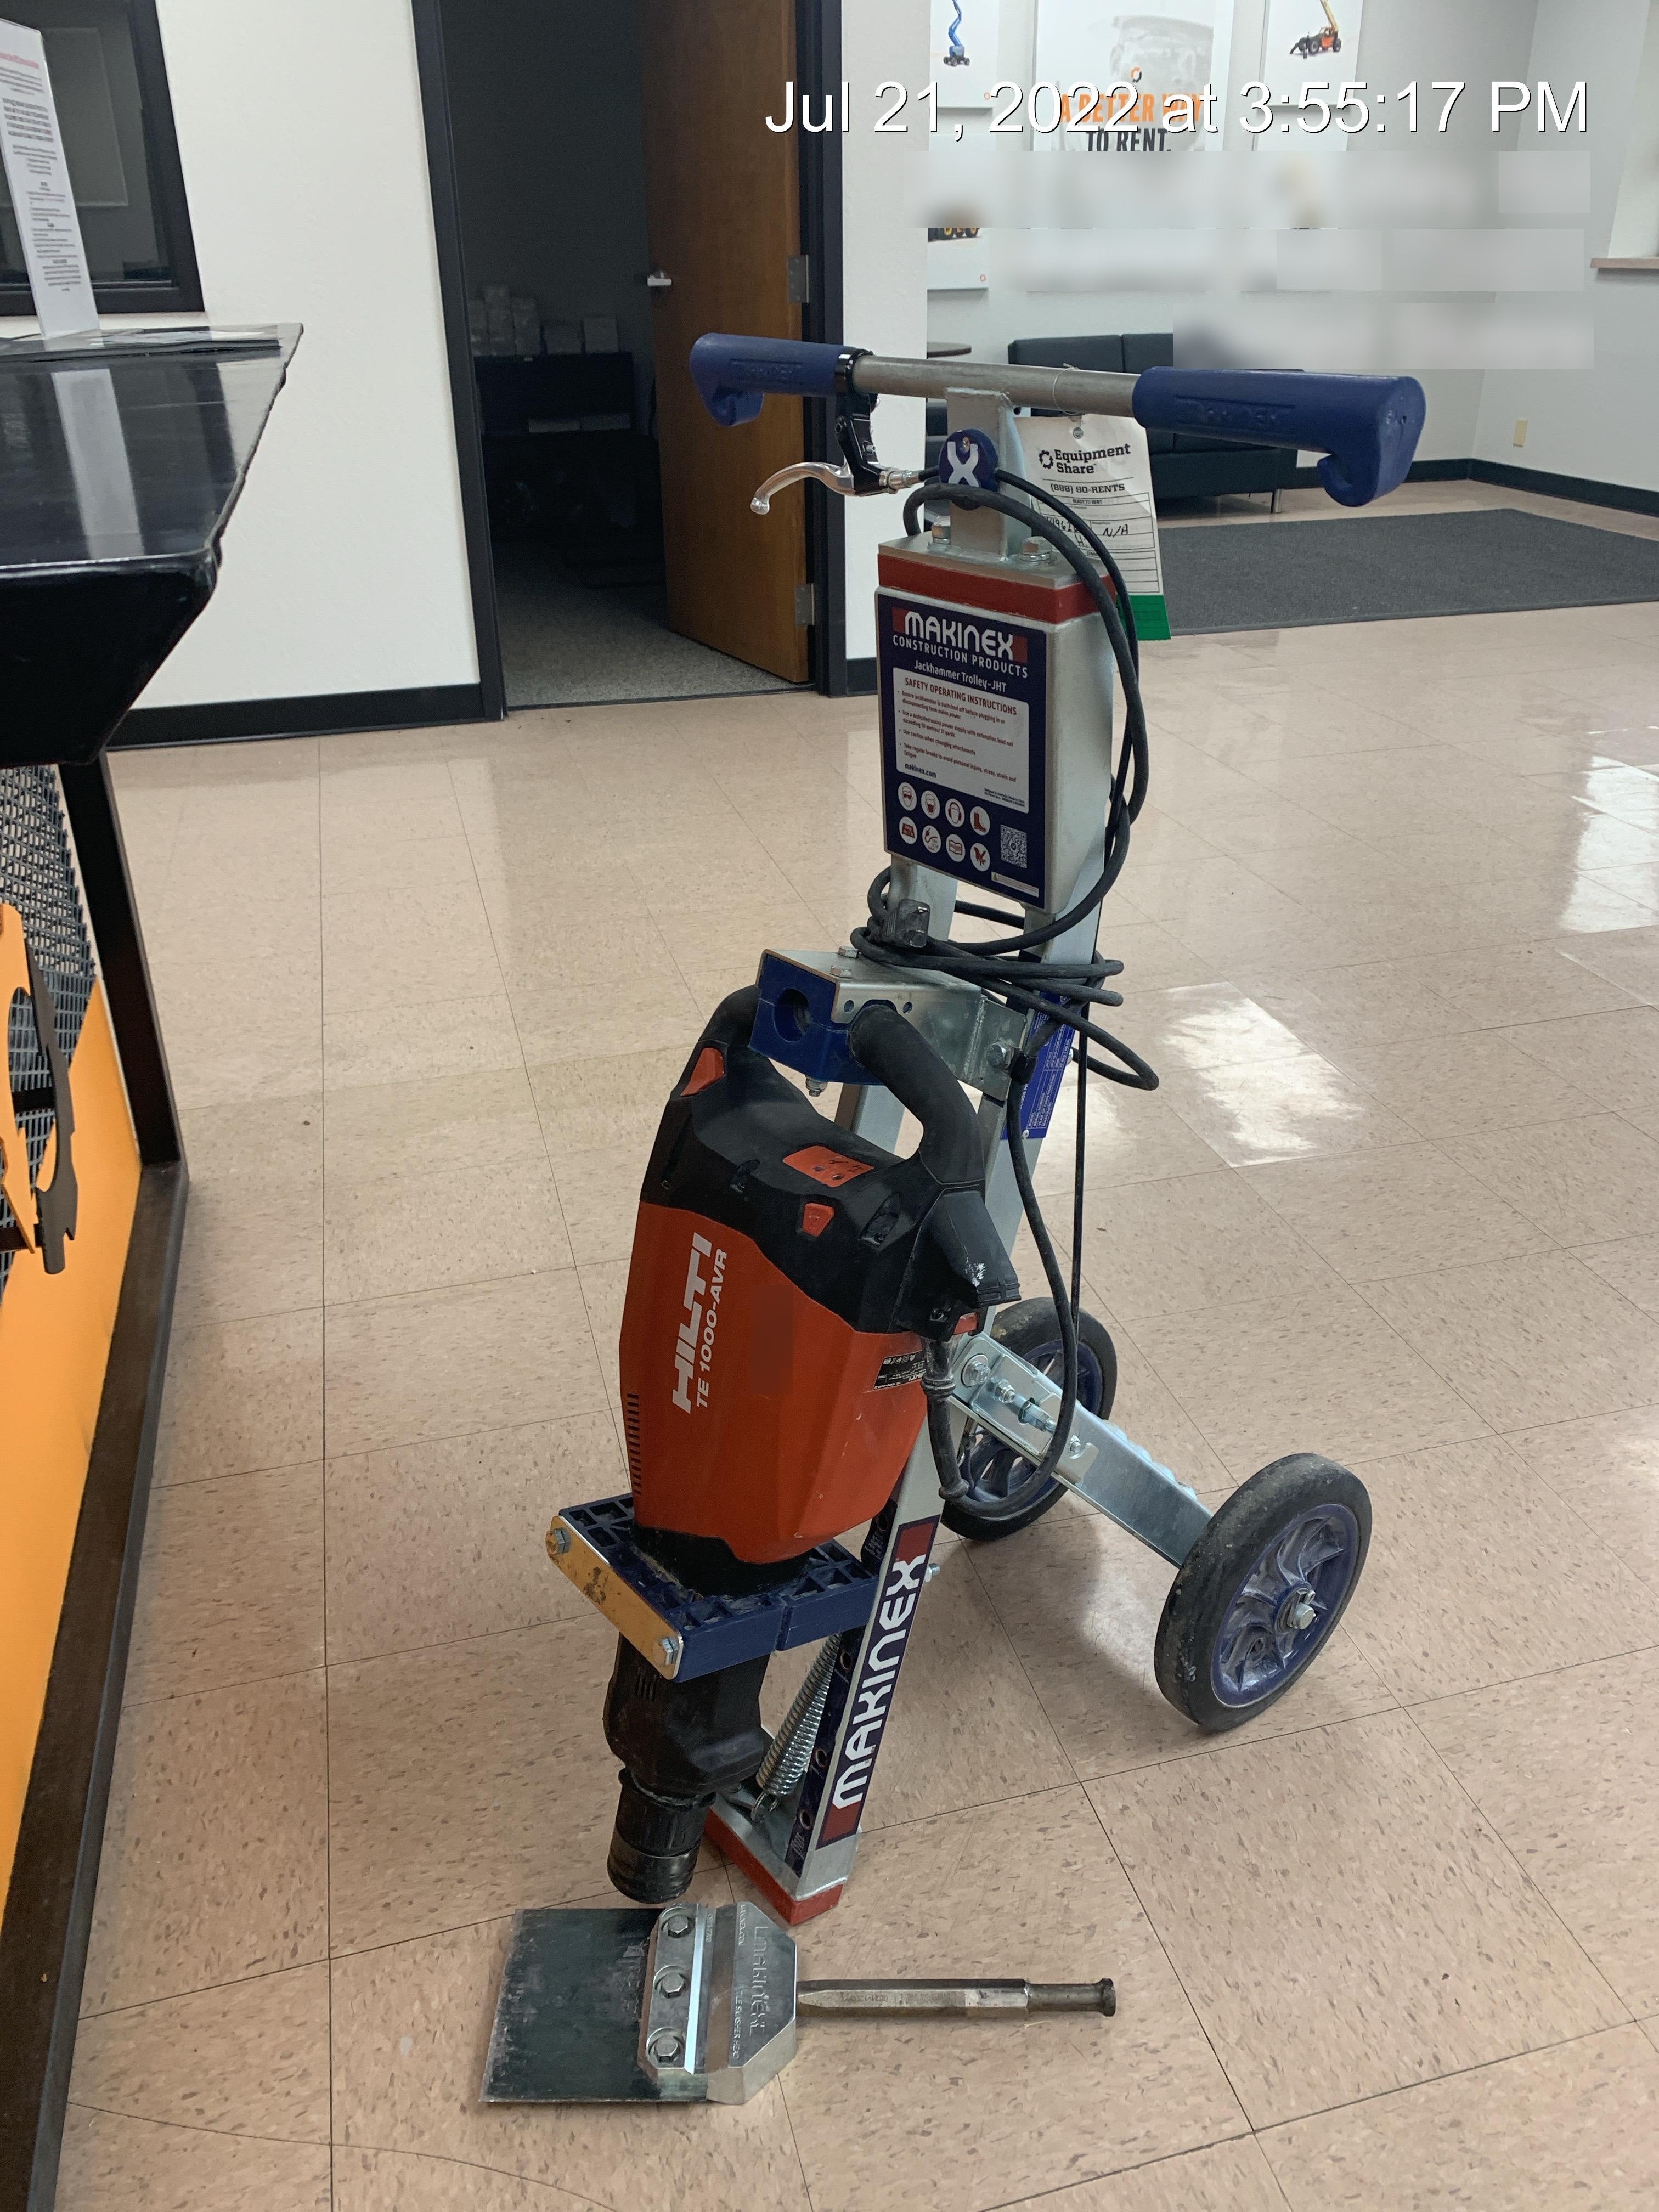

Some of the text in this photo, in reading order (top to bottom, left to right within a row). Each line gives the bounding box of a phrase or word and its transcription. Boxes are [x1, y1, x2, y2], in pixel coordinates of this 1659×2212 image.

[1079, 93, 1155, 123] BETTER
[1086, 128, 1109, 151] TO
[1054, 443, 1131, 463] Equipment
[1051, 483, 1125, 494] (888) 80-RENTS
[1103, 524, 1129, 538] N/A
[905, 611, 1013, 661] MAKINEX
[893, 635, 1028, 679] CONSTRUCTION PRODUCTS
[914, 660, 1007, 692] Jackhammer Trolley-JHT
[905, 677, 1017, 715] SAFETY OPERATING INSTRUCTIONS
[903, 718, 921, 729] exceeding
[913, 713, 930, 723] dedicated
[942, 721, 953, 730] power
[954, 725, 966, 734] supply
[977, 732, 997, 742] extension
[904, 749, 917, 759] fatigue
[912, 745, 925, 754] regular
[943, 754, 953, 763] avoid
[953, 759, 970, 768] personal
[935, 738, 952, 749] changing
[905, 763, 937, 778] makinex.com
[672, 1232, 712, 1414] HILTI
[696, 1248, 727, 1408] TE 1000-AVR
[832, 1554, 926, 1809] MAKINEX
